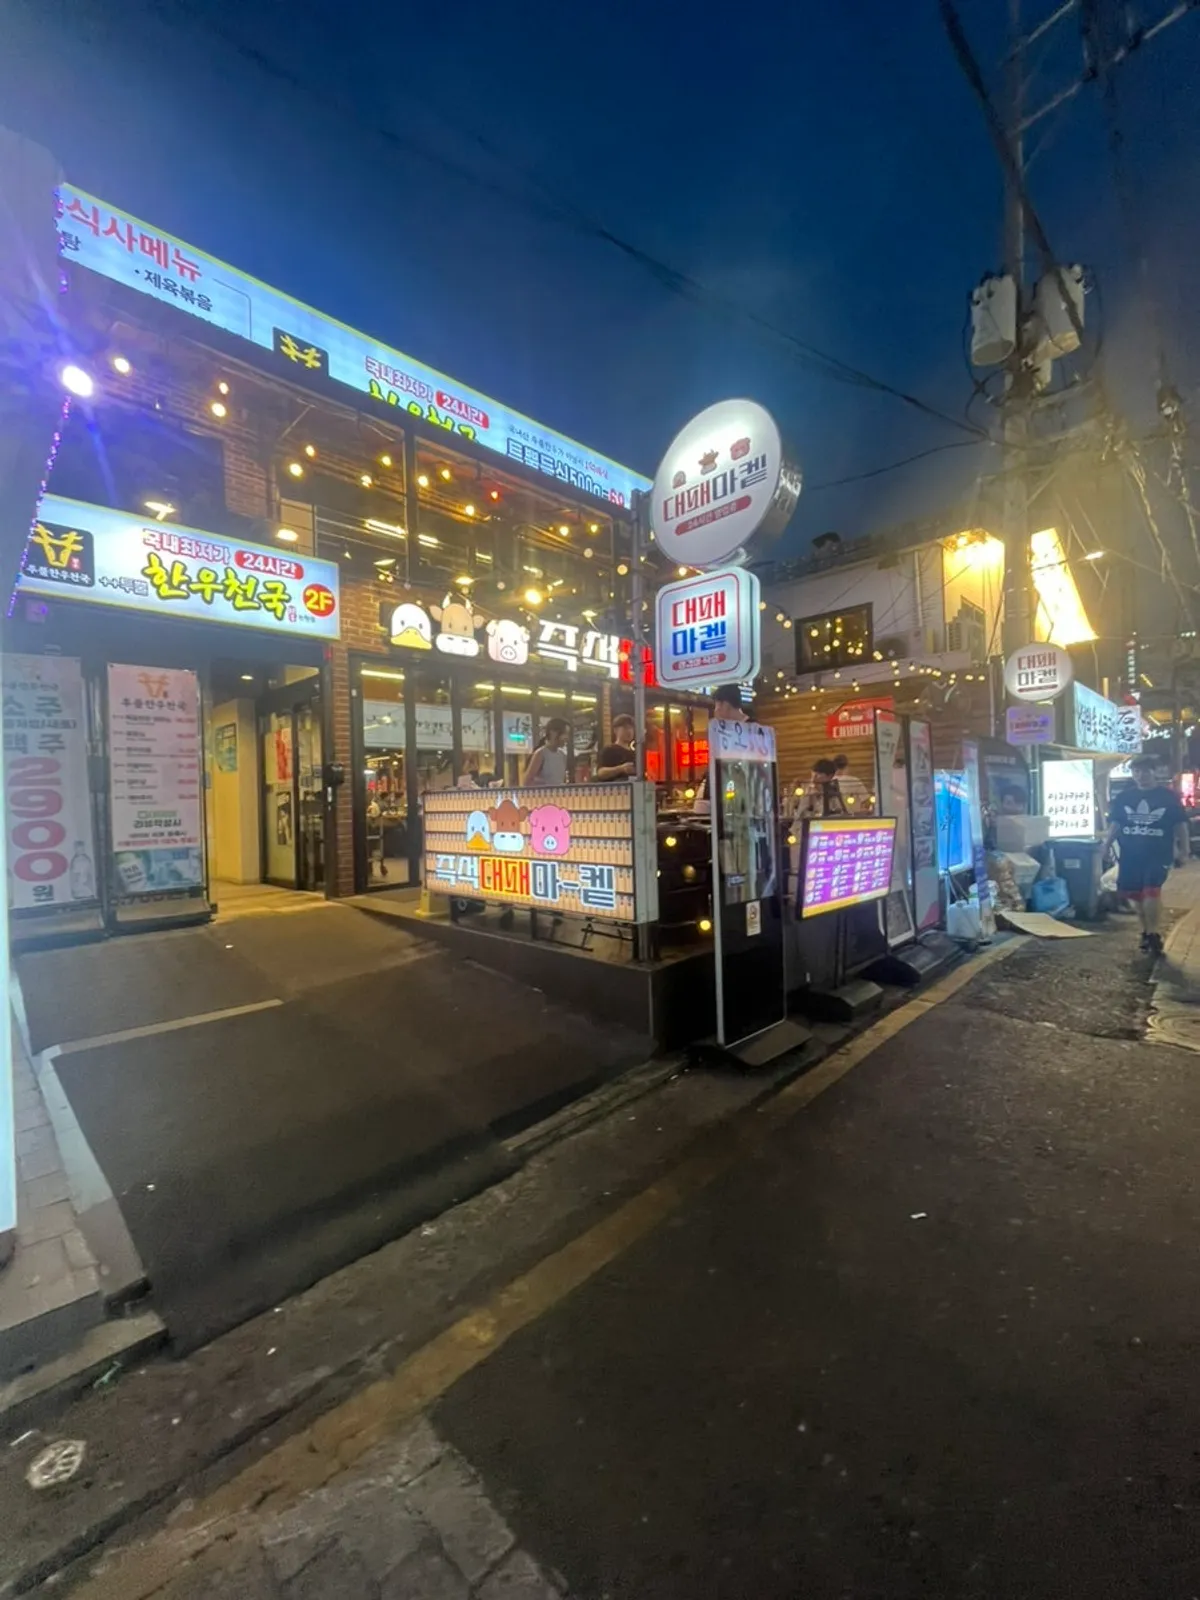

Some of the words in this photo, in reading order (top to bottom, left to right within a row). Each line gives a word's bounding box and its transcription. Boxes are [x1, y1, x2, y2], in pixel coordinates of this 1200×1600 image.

[66, 198, 202, 282] 식사메뉴
[142, 553, 290, 620] 한우천국
[304, 587, 332, 612] 2F
[242, 552, 298, 579] 24시간
[1123, 826, 1165, 837] adidas
